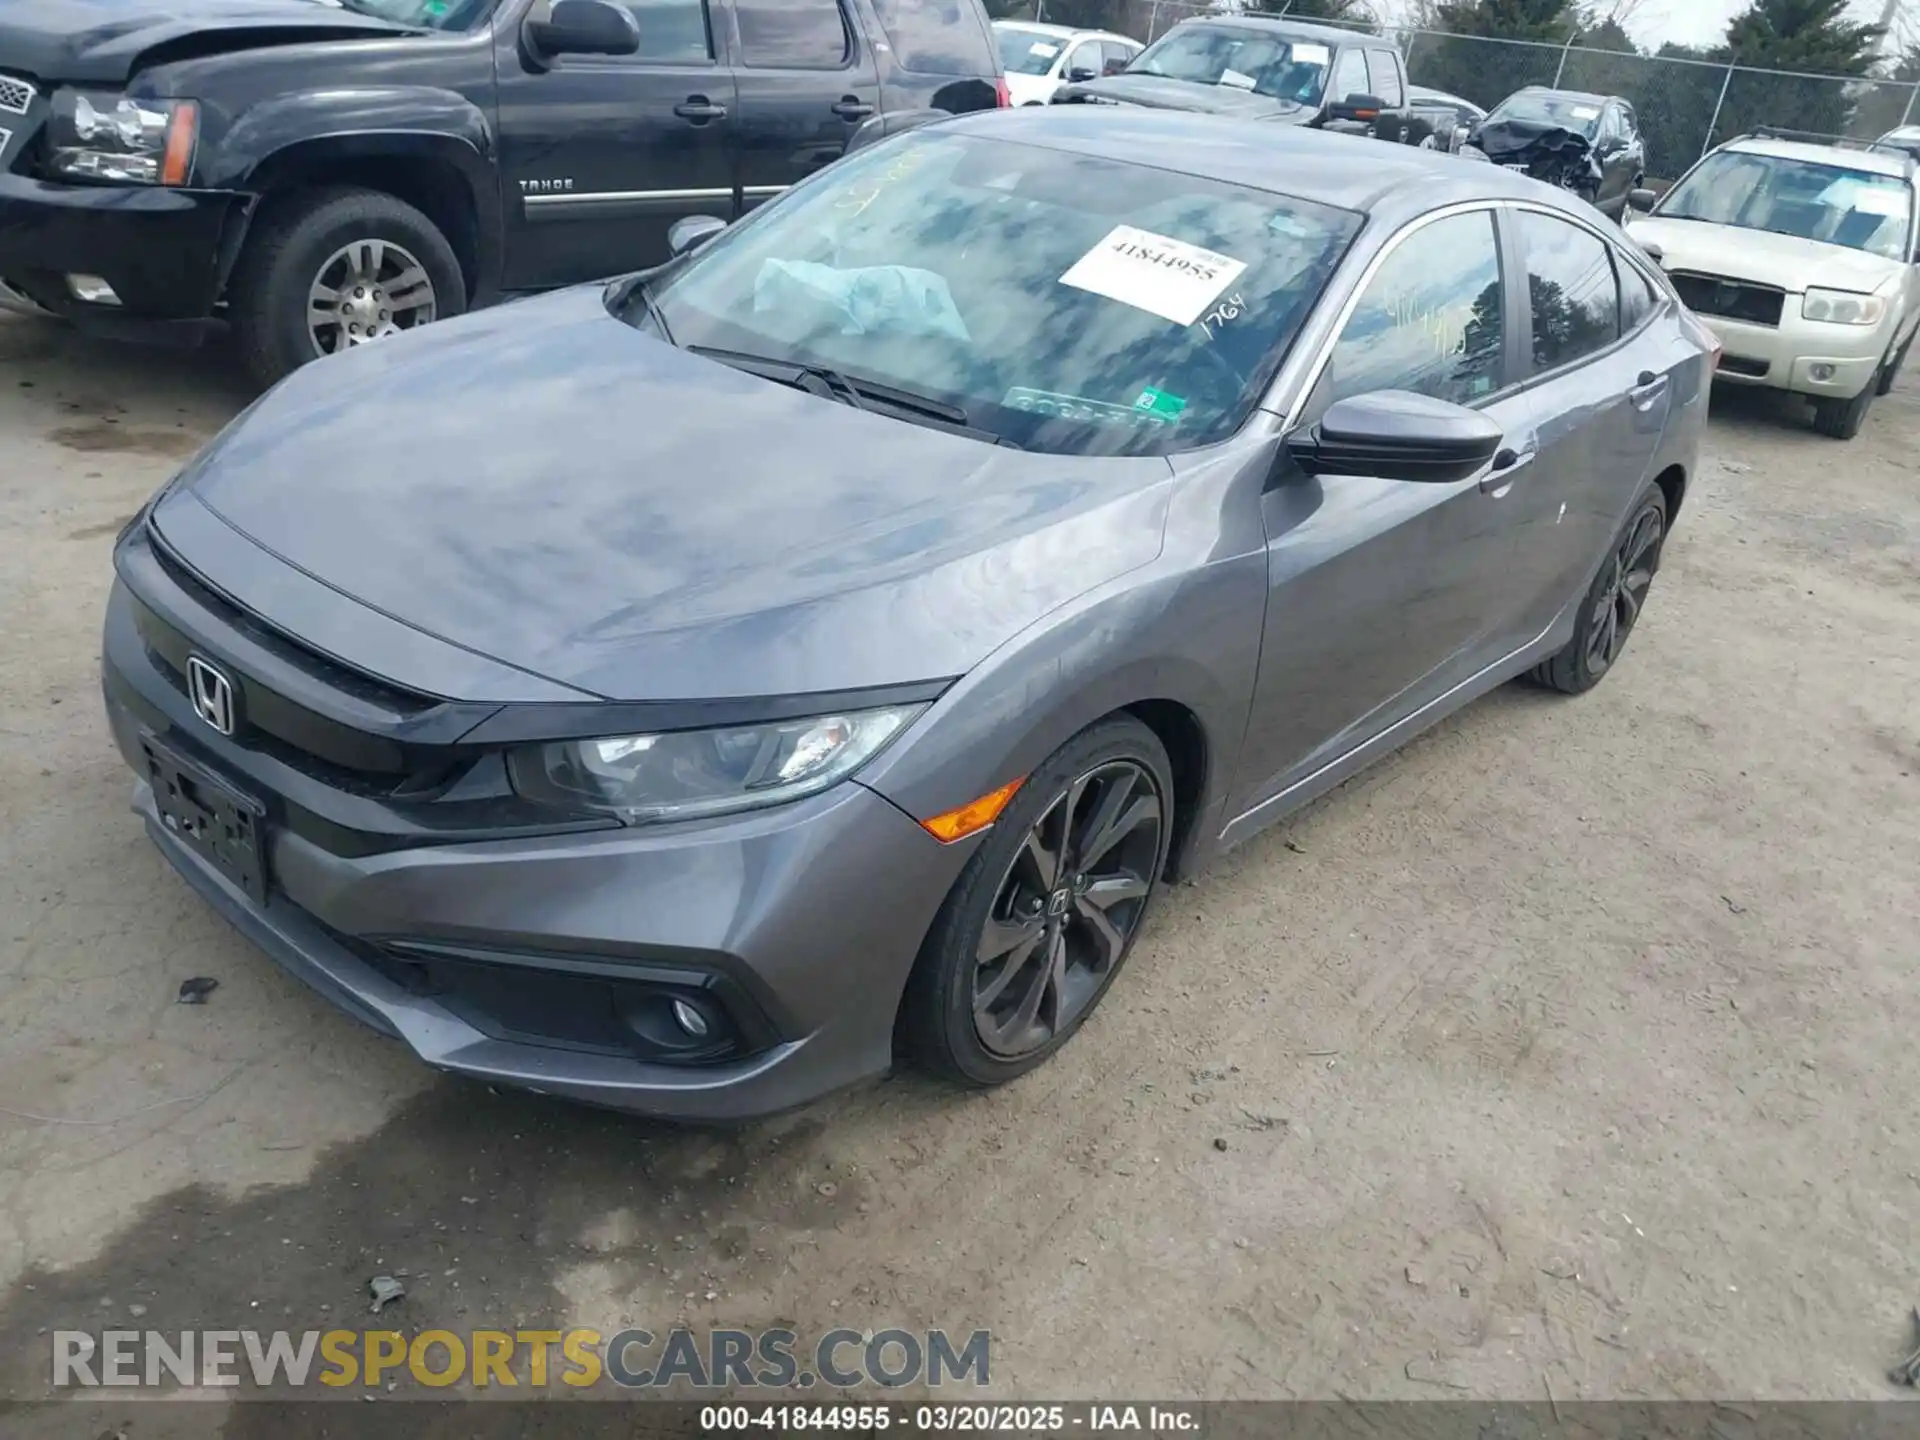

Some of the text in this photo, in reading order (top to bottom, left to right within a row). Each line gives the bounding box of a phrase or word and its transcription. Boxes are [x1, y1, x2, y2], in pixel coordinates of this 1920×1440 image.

[519, 178, 574, 191] TAHOE
[1111, 240, 1218, 281] 41844955
[1199, 292, 1248, 340] 1764
